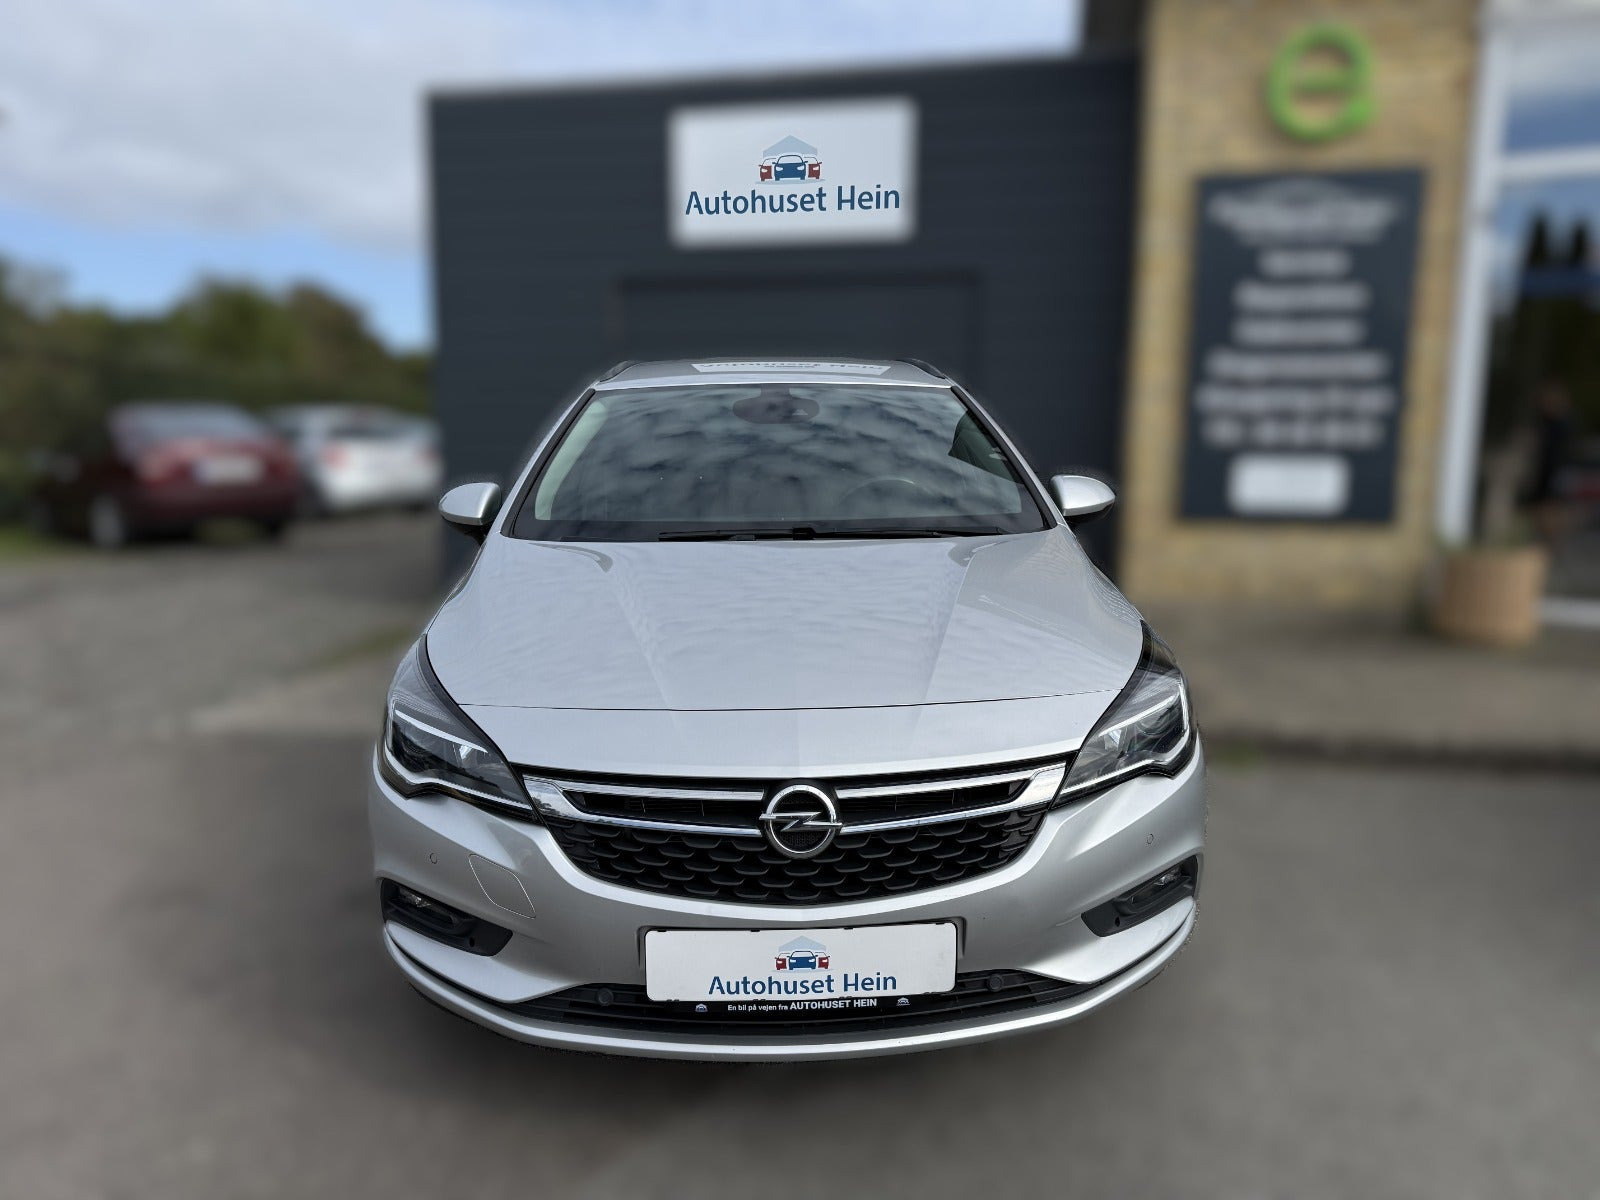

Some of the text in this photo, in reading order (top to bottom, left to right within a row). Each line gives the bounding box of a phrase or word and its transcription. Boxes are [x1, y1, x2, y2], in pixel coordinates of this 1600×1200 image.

[685, 184, 900, 216] Autohuset Hein
[708, 971, 897, 995] Autohuset Hein
[738, 1003, 747, 1011] bil
[758, 1004, 777, 1012] vejen
[789, 1001, 851, 1010] AUTOHUSET
[853, 998, 877, 1007] HEIN
